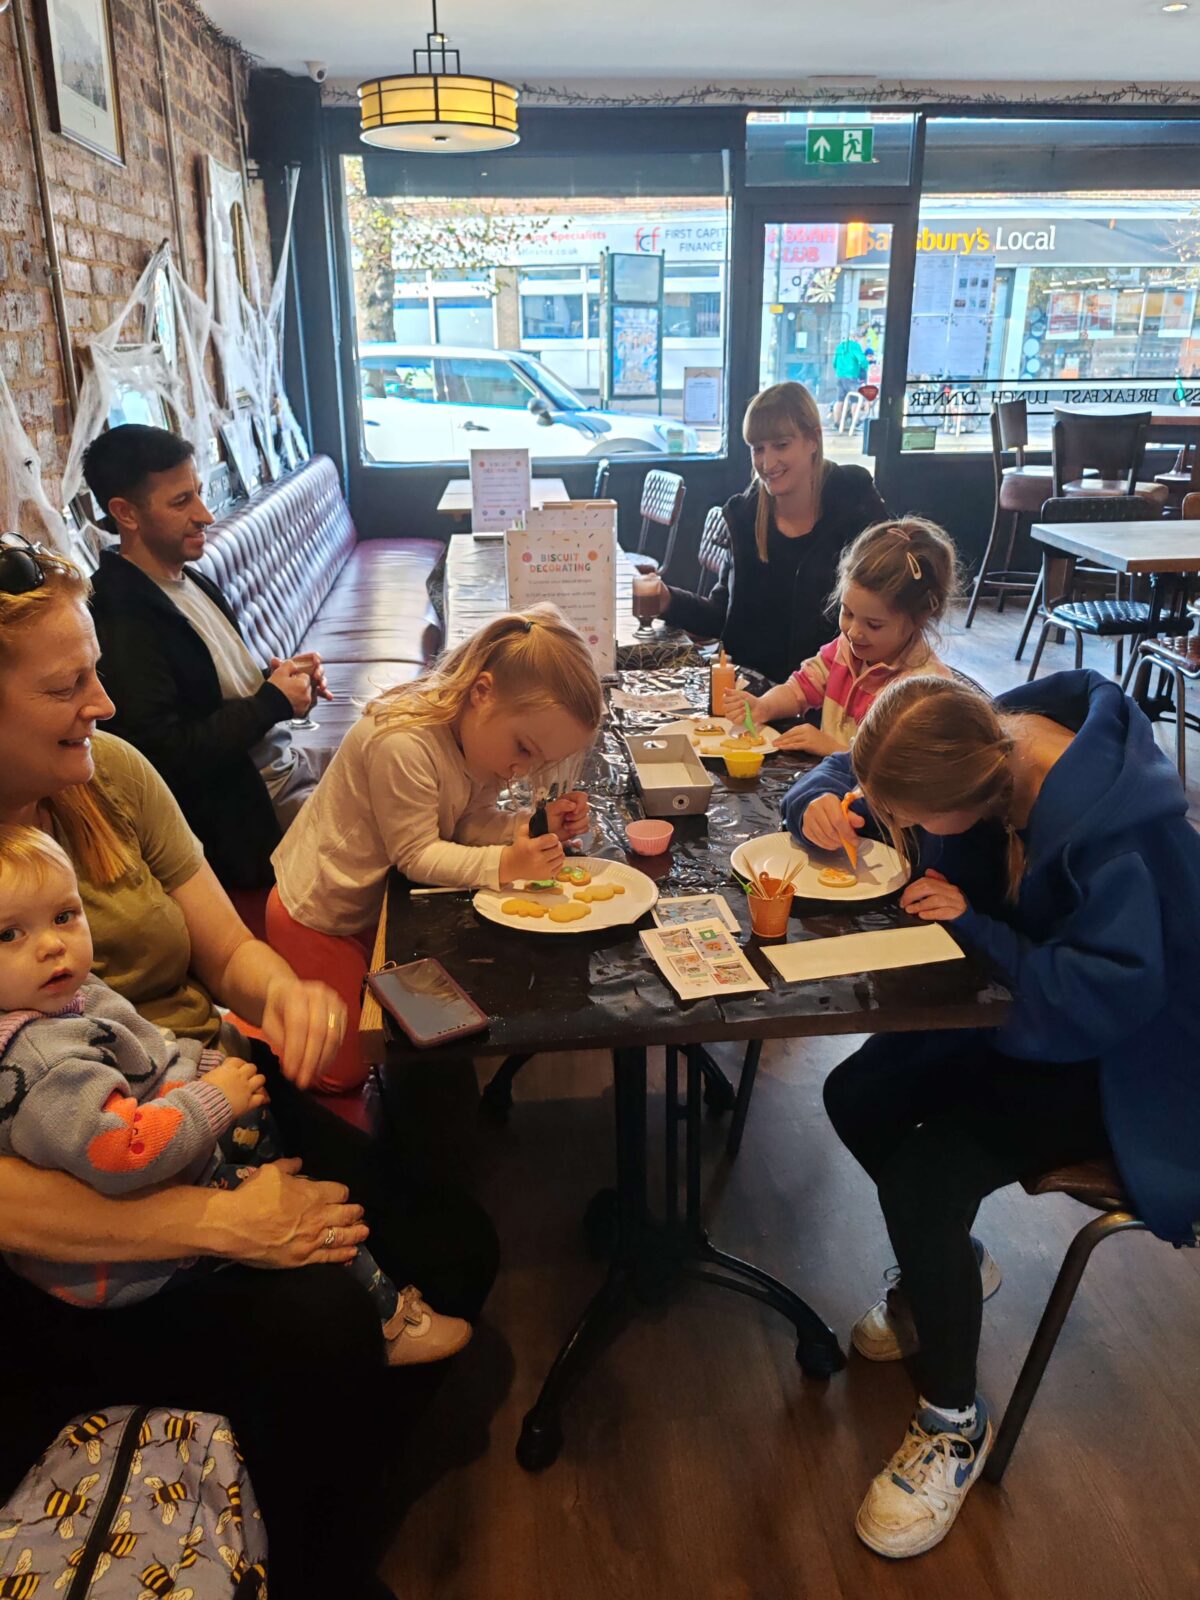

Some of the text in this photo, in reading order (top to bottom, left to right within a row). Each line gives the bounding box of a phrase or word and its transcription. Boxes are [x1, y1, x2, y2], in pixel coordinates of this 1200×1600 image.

[552, 230, 607, 243] Specialists
[665, 227, 728, 239] FIRST CAPIT
[995, 225, 1056, 251] Local
[680, 241, 723, 252] FINANCE
[540, 553, 579, 562] BISCUIT
[529, 563, 591, 573] DECORATING
